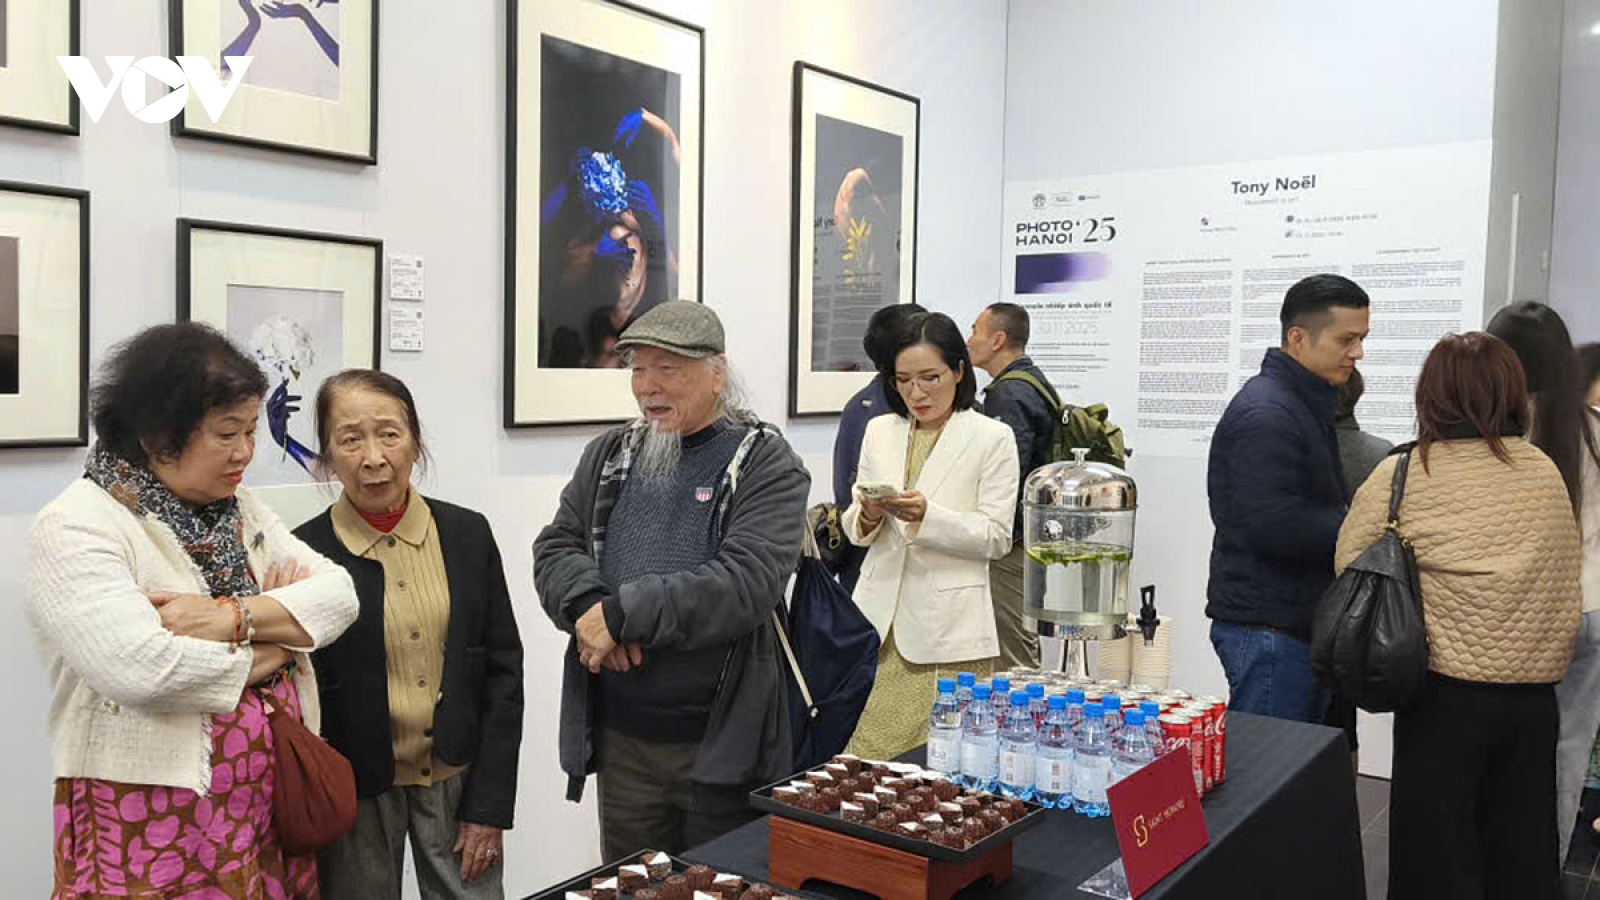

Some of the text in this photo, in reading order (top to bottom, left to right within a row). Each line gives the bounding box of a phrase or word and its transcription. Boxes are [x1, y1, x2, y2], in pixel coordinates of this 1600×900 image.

[1231, 175, 1316, 196] Tony Noël
[1016, 220, 1073, 233] PHOTO
[1016, 233, 1073, 246] HANOI
